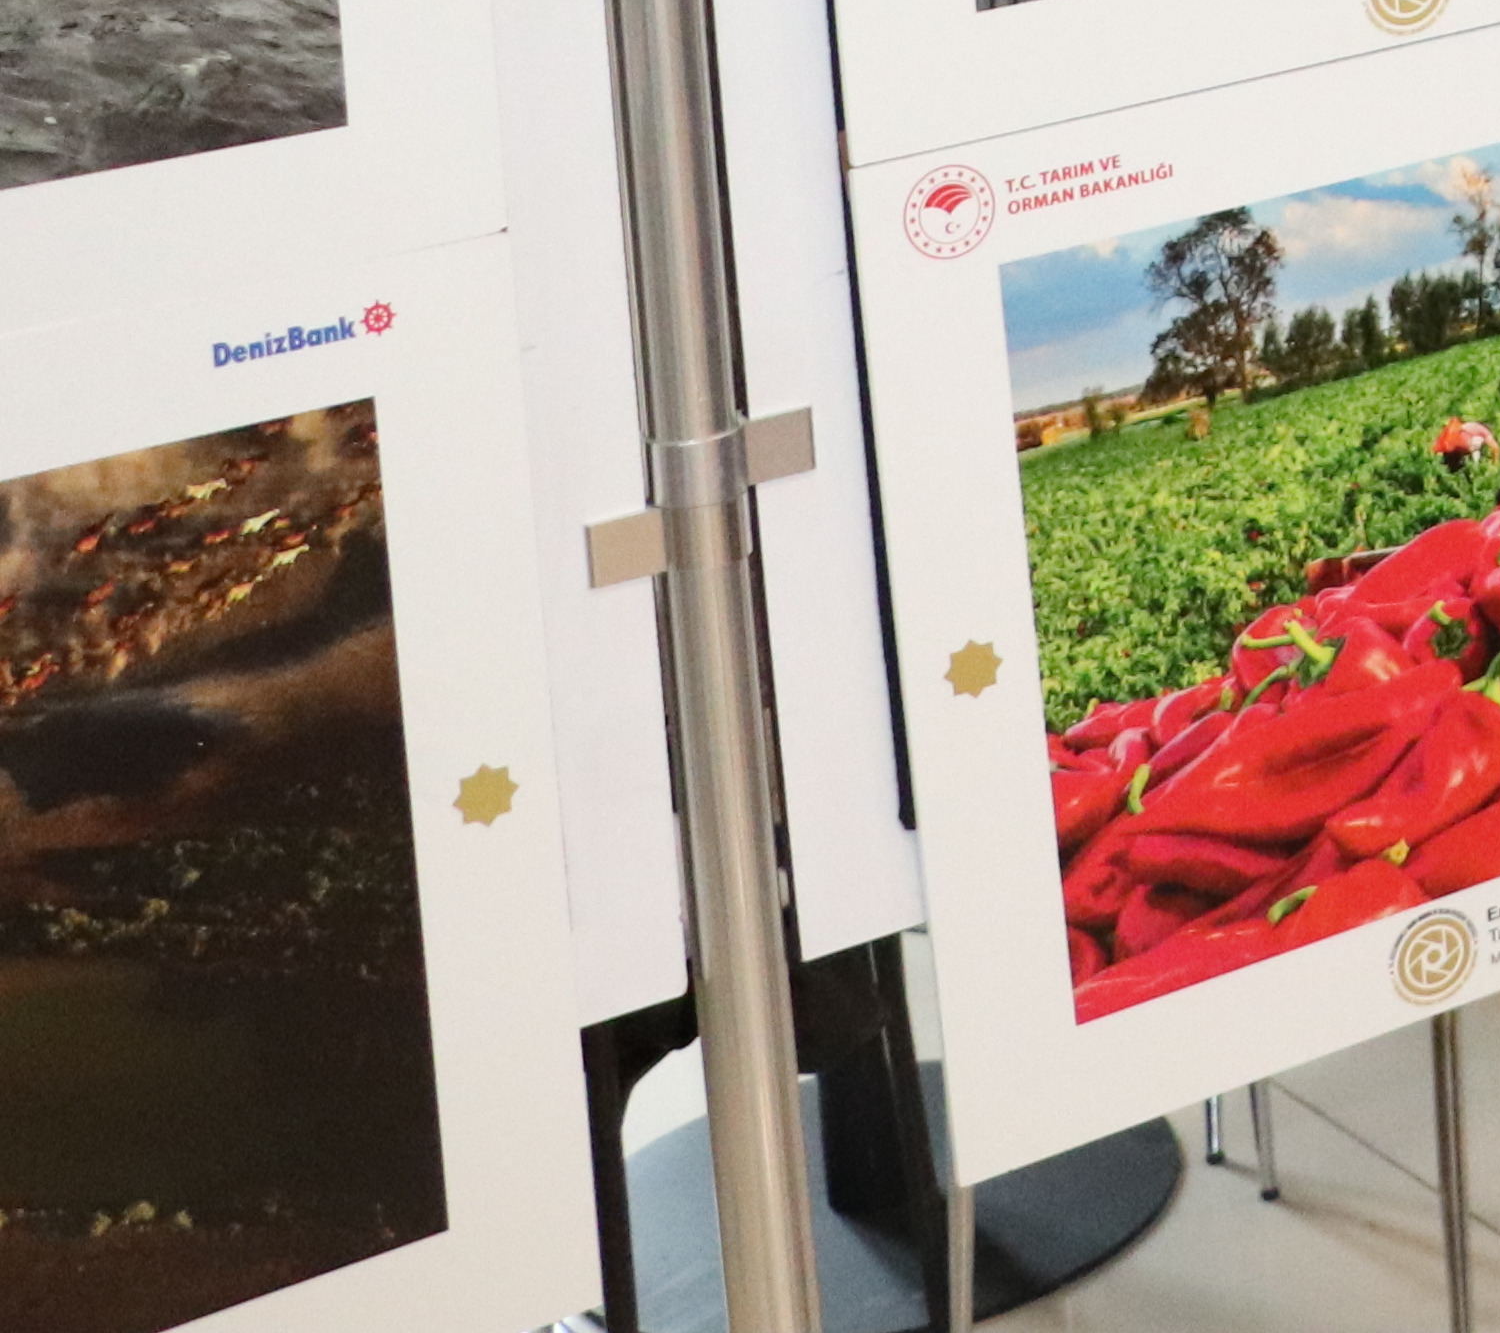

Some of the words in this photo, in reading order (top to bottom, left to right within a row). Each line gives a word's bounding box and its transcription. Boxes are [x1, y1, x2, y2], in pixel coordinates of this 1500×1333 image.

[1004, 174, 1037, 194] T.C.
[1040, 160, 1095, 186] TARIM
[1098, 153, 1122, 171] VE
[1007, 186, 1075, 216] ORMAN
[1079, 162, 1174, 199] BAKANLIĞI
[212, 316, 357, 369] DenizBank
